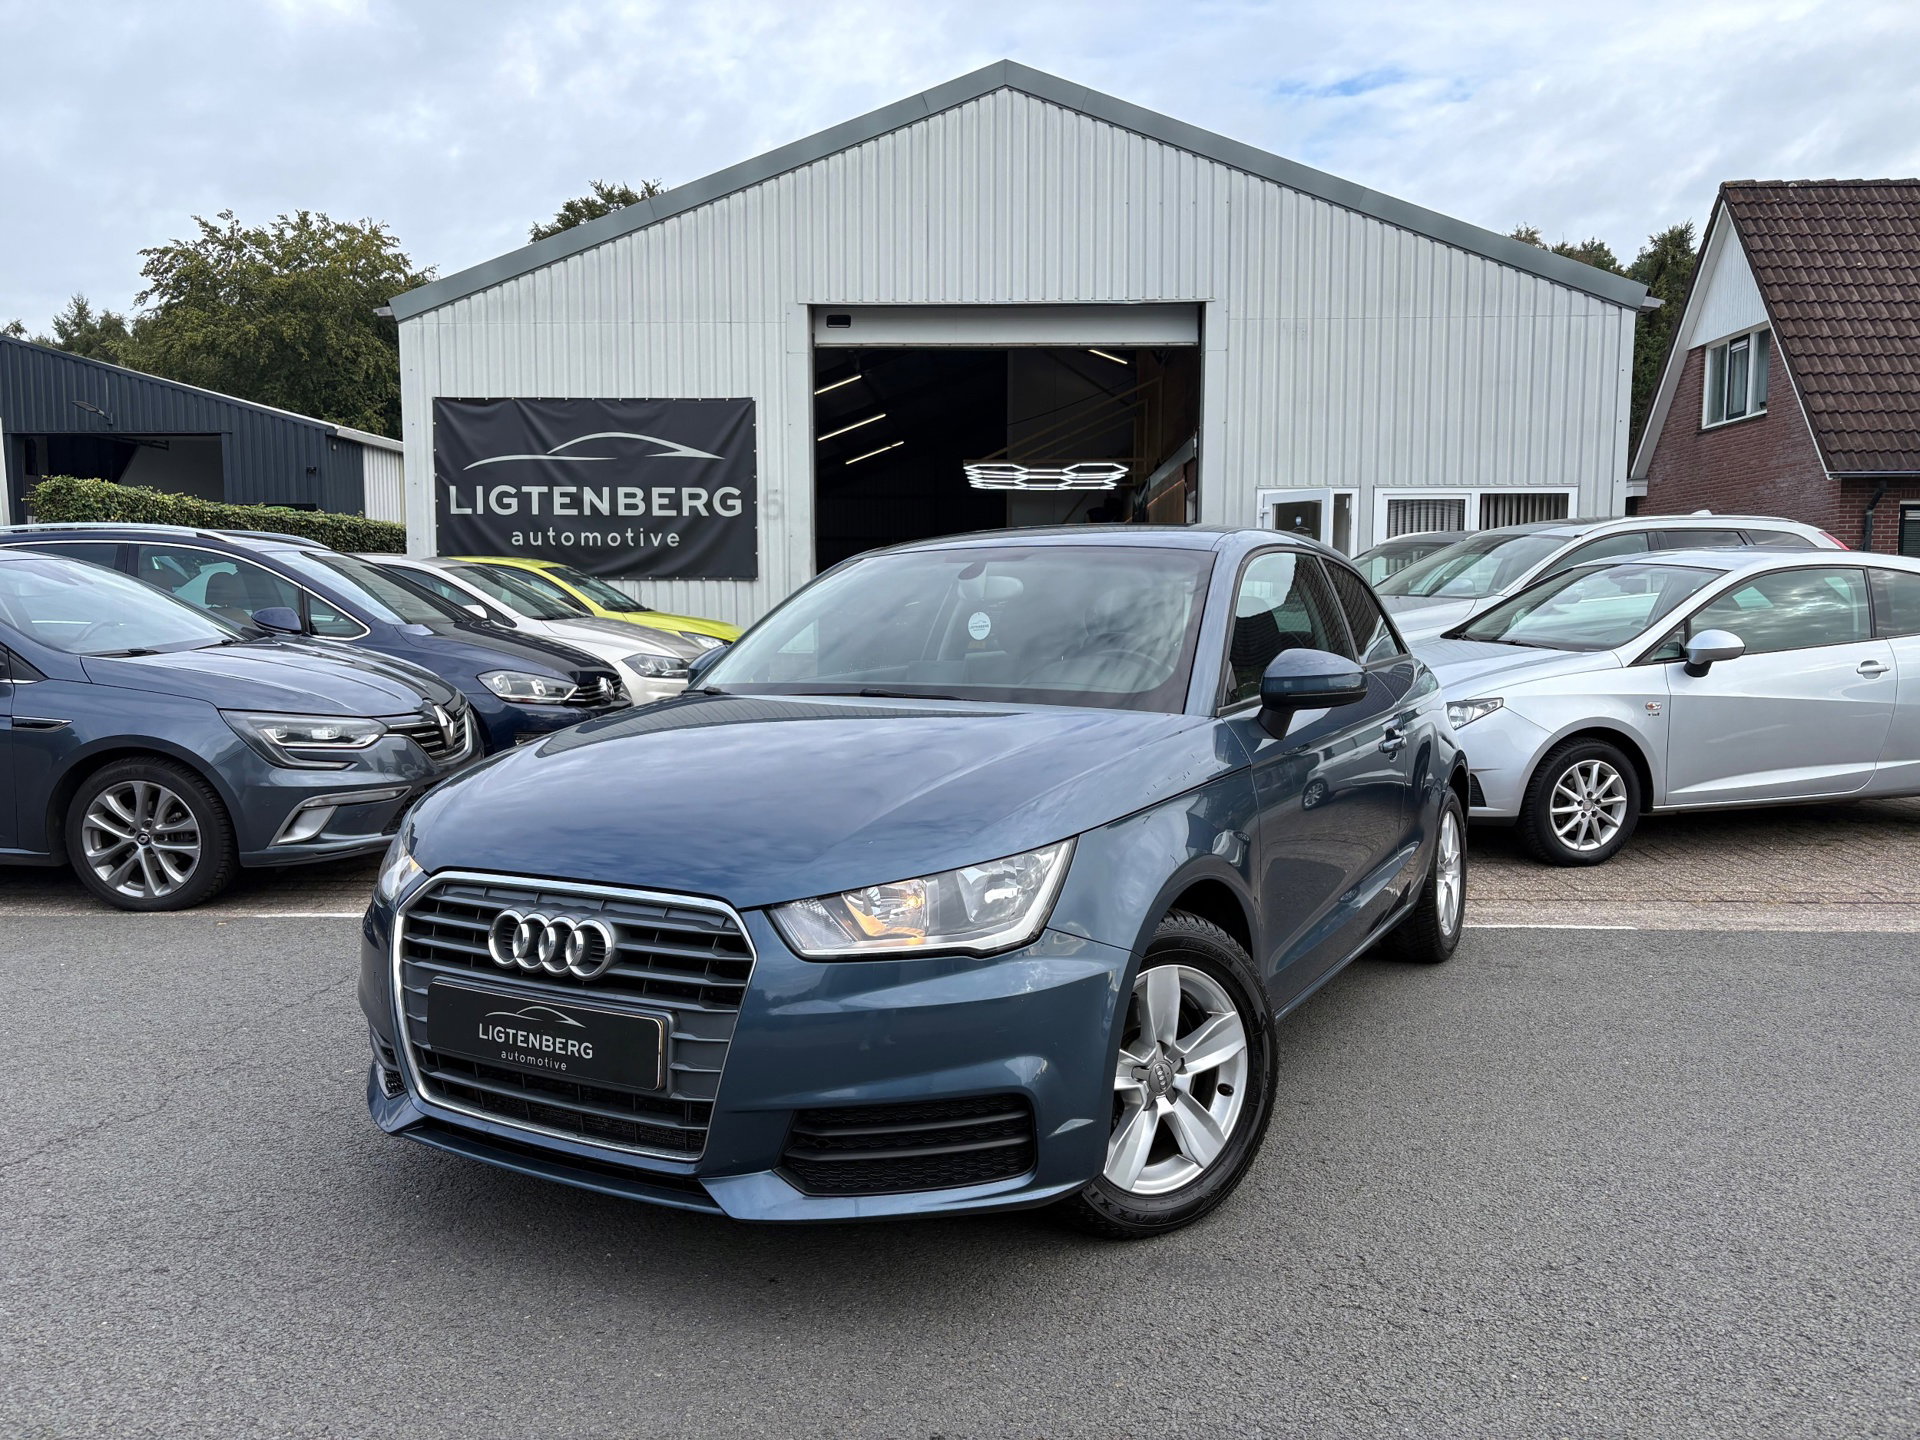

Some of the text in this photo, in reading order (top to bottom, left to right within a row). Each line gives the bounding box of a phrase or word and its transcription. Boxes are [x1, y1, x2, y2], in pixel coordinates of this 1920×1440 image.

[449, 486, 742, 517] LIGTENBERG
[511, 528, 680, 547] automotive
[478, 1023, 593, 1058] LIGTENBERG
[501, 1050, 567, 1070] automotive
